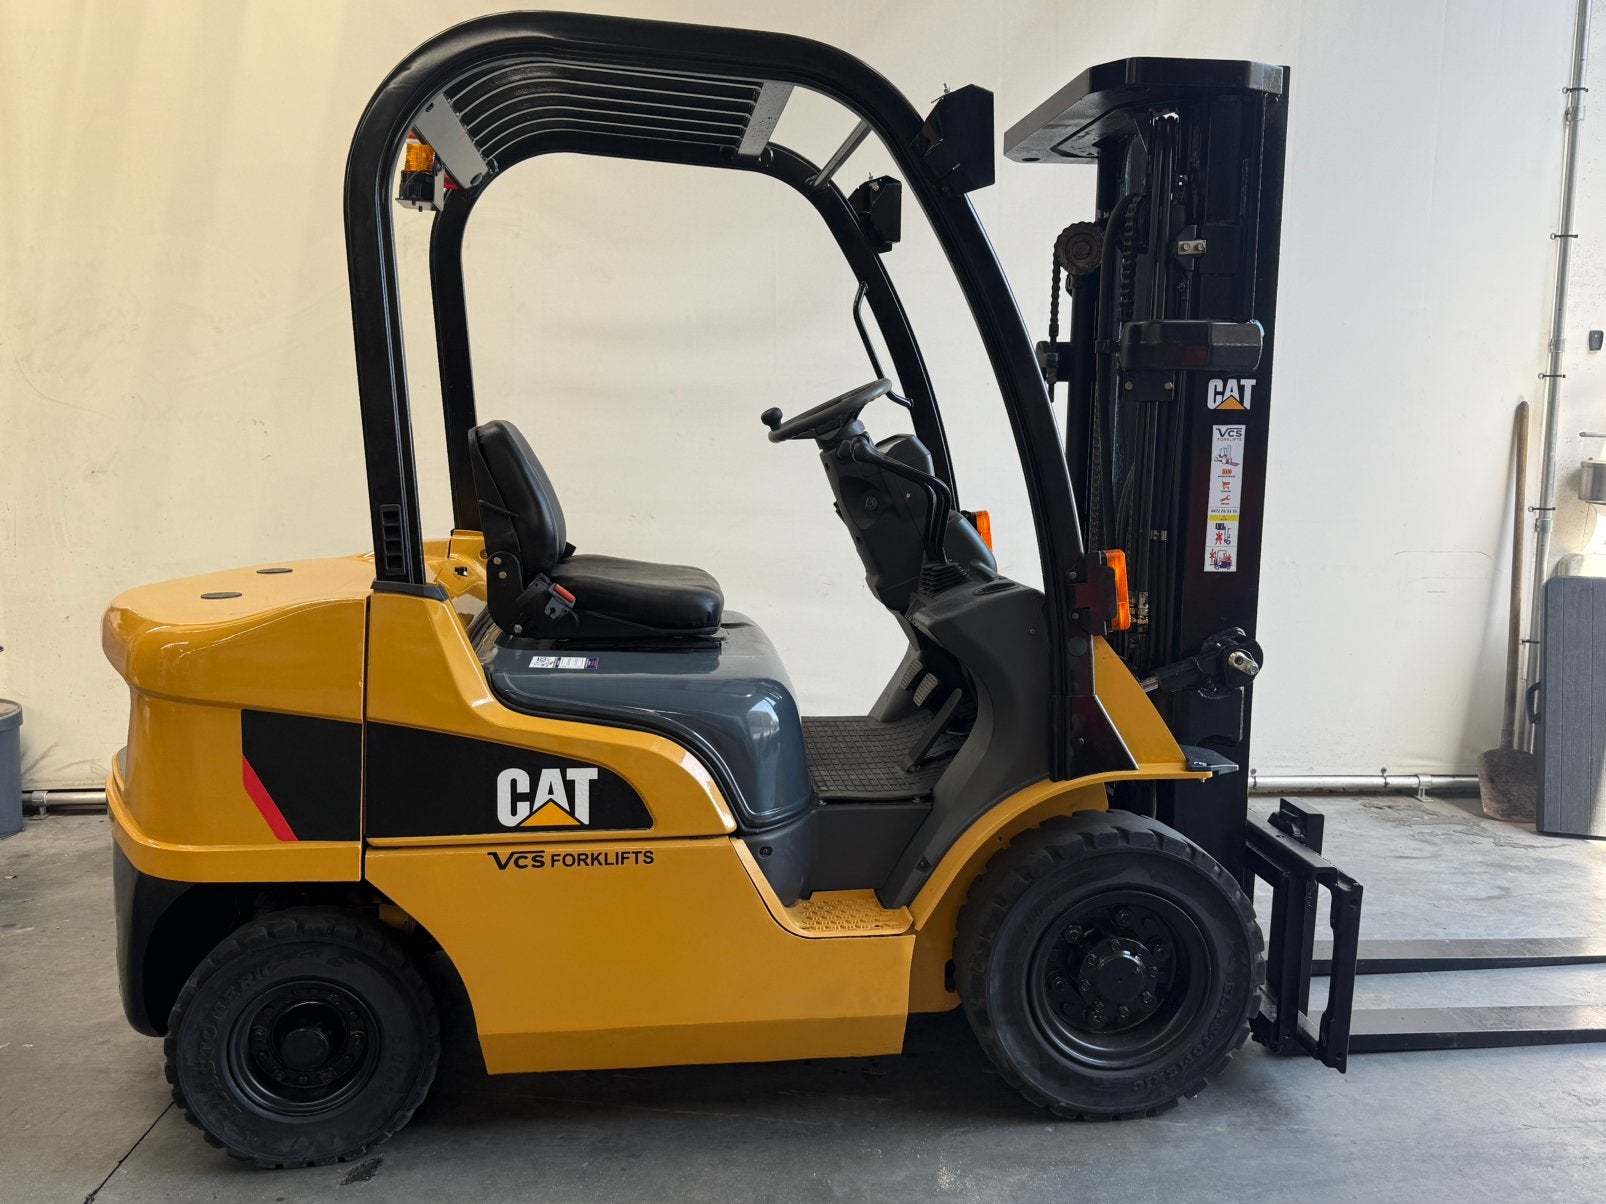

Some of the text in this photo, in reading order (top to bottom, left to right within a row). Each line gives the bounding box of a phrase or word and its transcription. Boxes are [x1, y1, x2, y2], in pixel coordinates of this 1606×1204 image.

[1207, 378, 1256, 410] CAT
[1216, 427, 1242, 438] VCS
[496, 767, 599, 827] CAT
[487, 849, 655, 871] VCS FORKLIFTS
